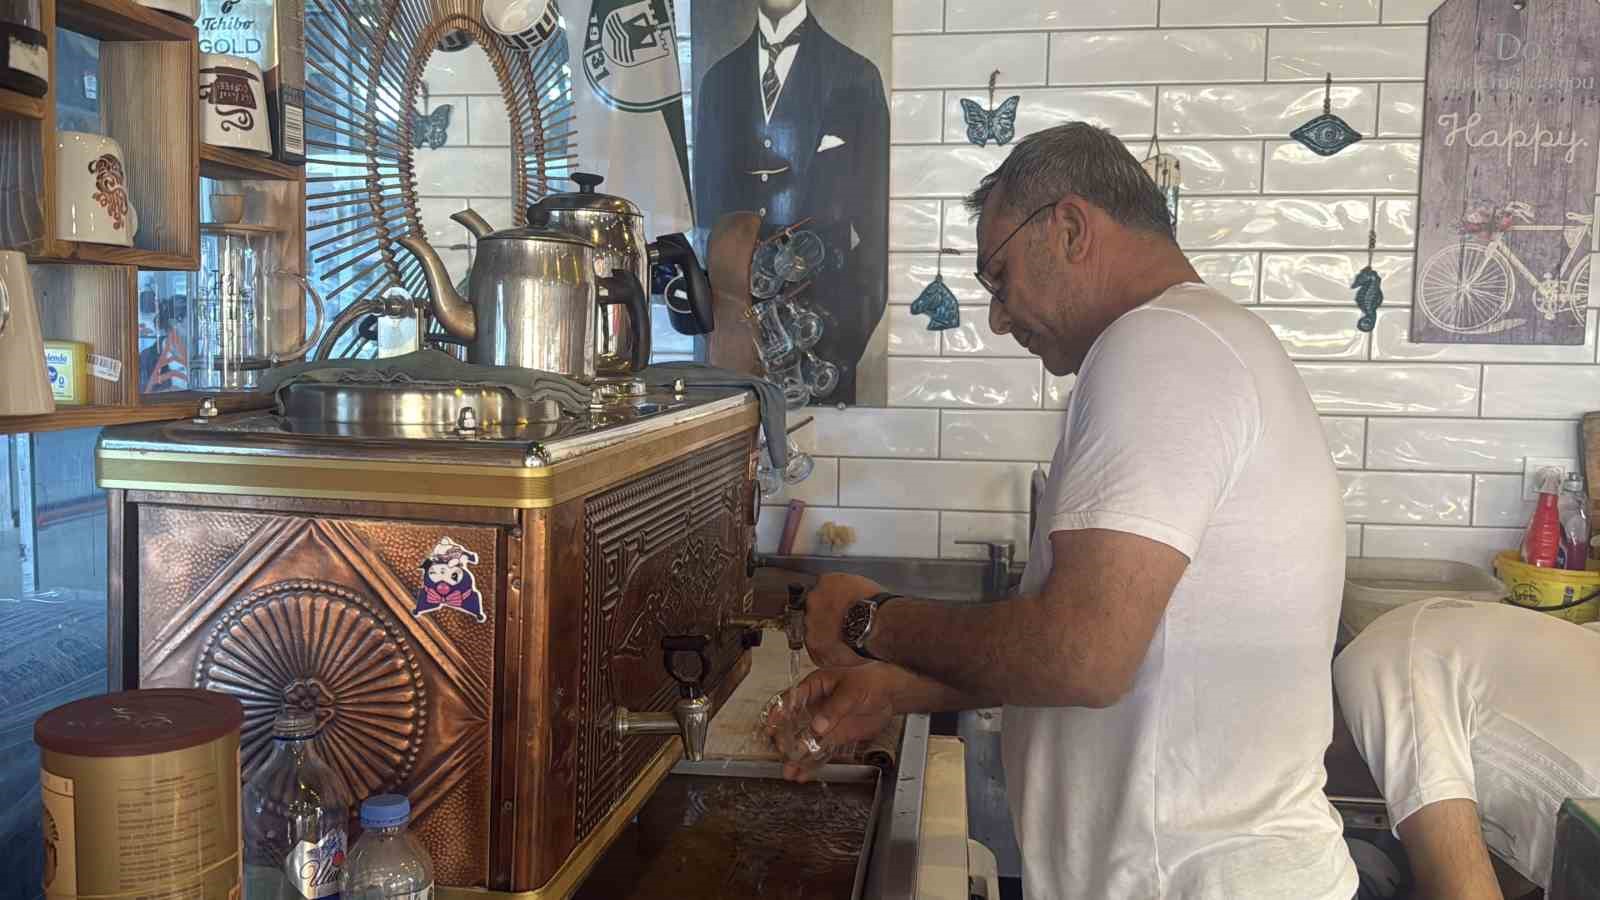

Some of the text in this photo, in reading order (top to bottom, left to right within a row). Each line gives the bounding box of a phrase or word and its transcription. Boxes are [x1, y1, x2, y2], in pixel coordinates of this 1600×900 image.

[202, 17, 255, 32] Tchibo
[199, 38, 261, 54] GOLD
[1496, 32, 1542, 61] Do
